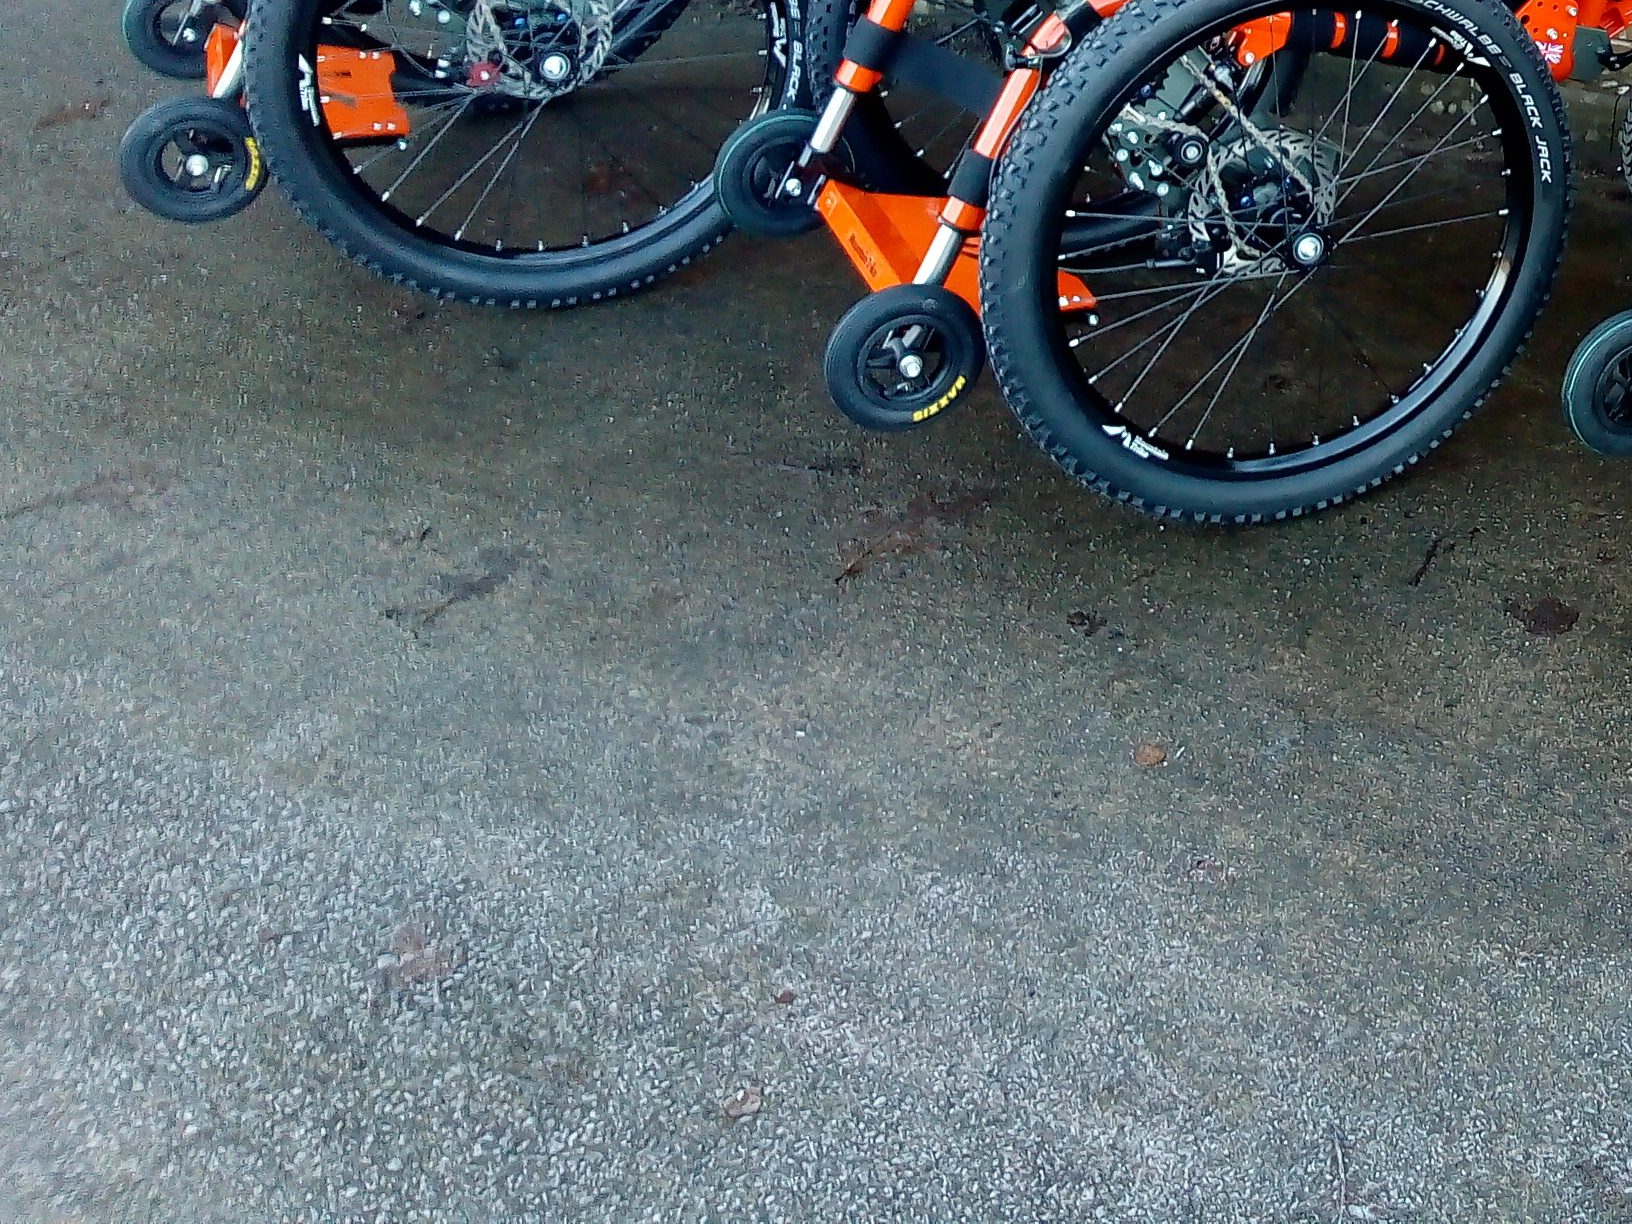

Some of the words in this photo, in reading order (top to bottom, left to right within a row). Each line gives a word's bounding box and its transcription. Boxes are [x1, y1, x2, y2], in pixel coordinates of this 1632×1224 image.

[787, 40, 803, 102] BLACK
[1509, 72, 1543, 129] BLACK
[1535, 135, 1552, 184] JACK
[912, 375, 967, 423] MAXXIS
